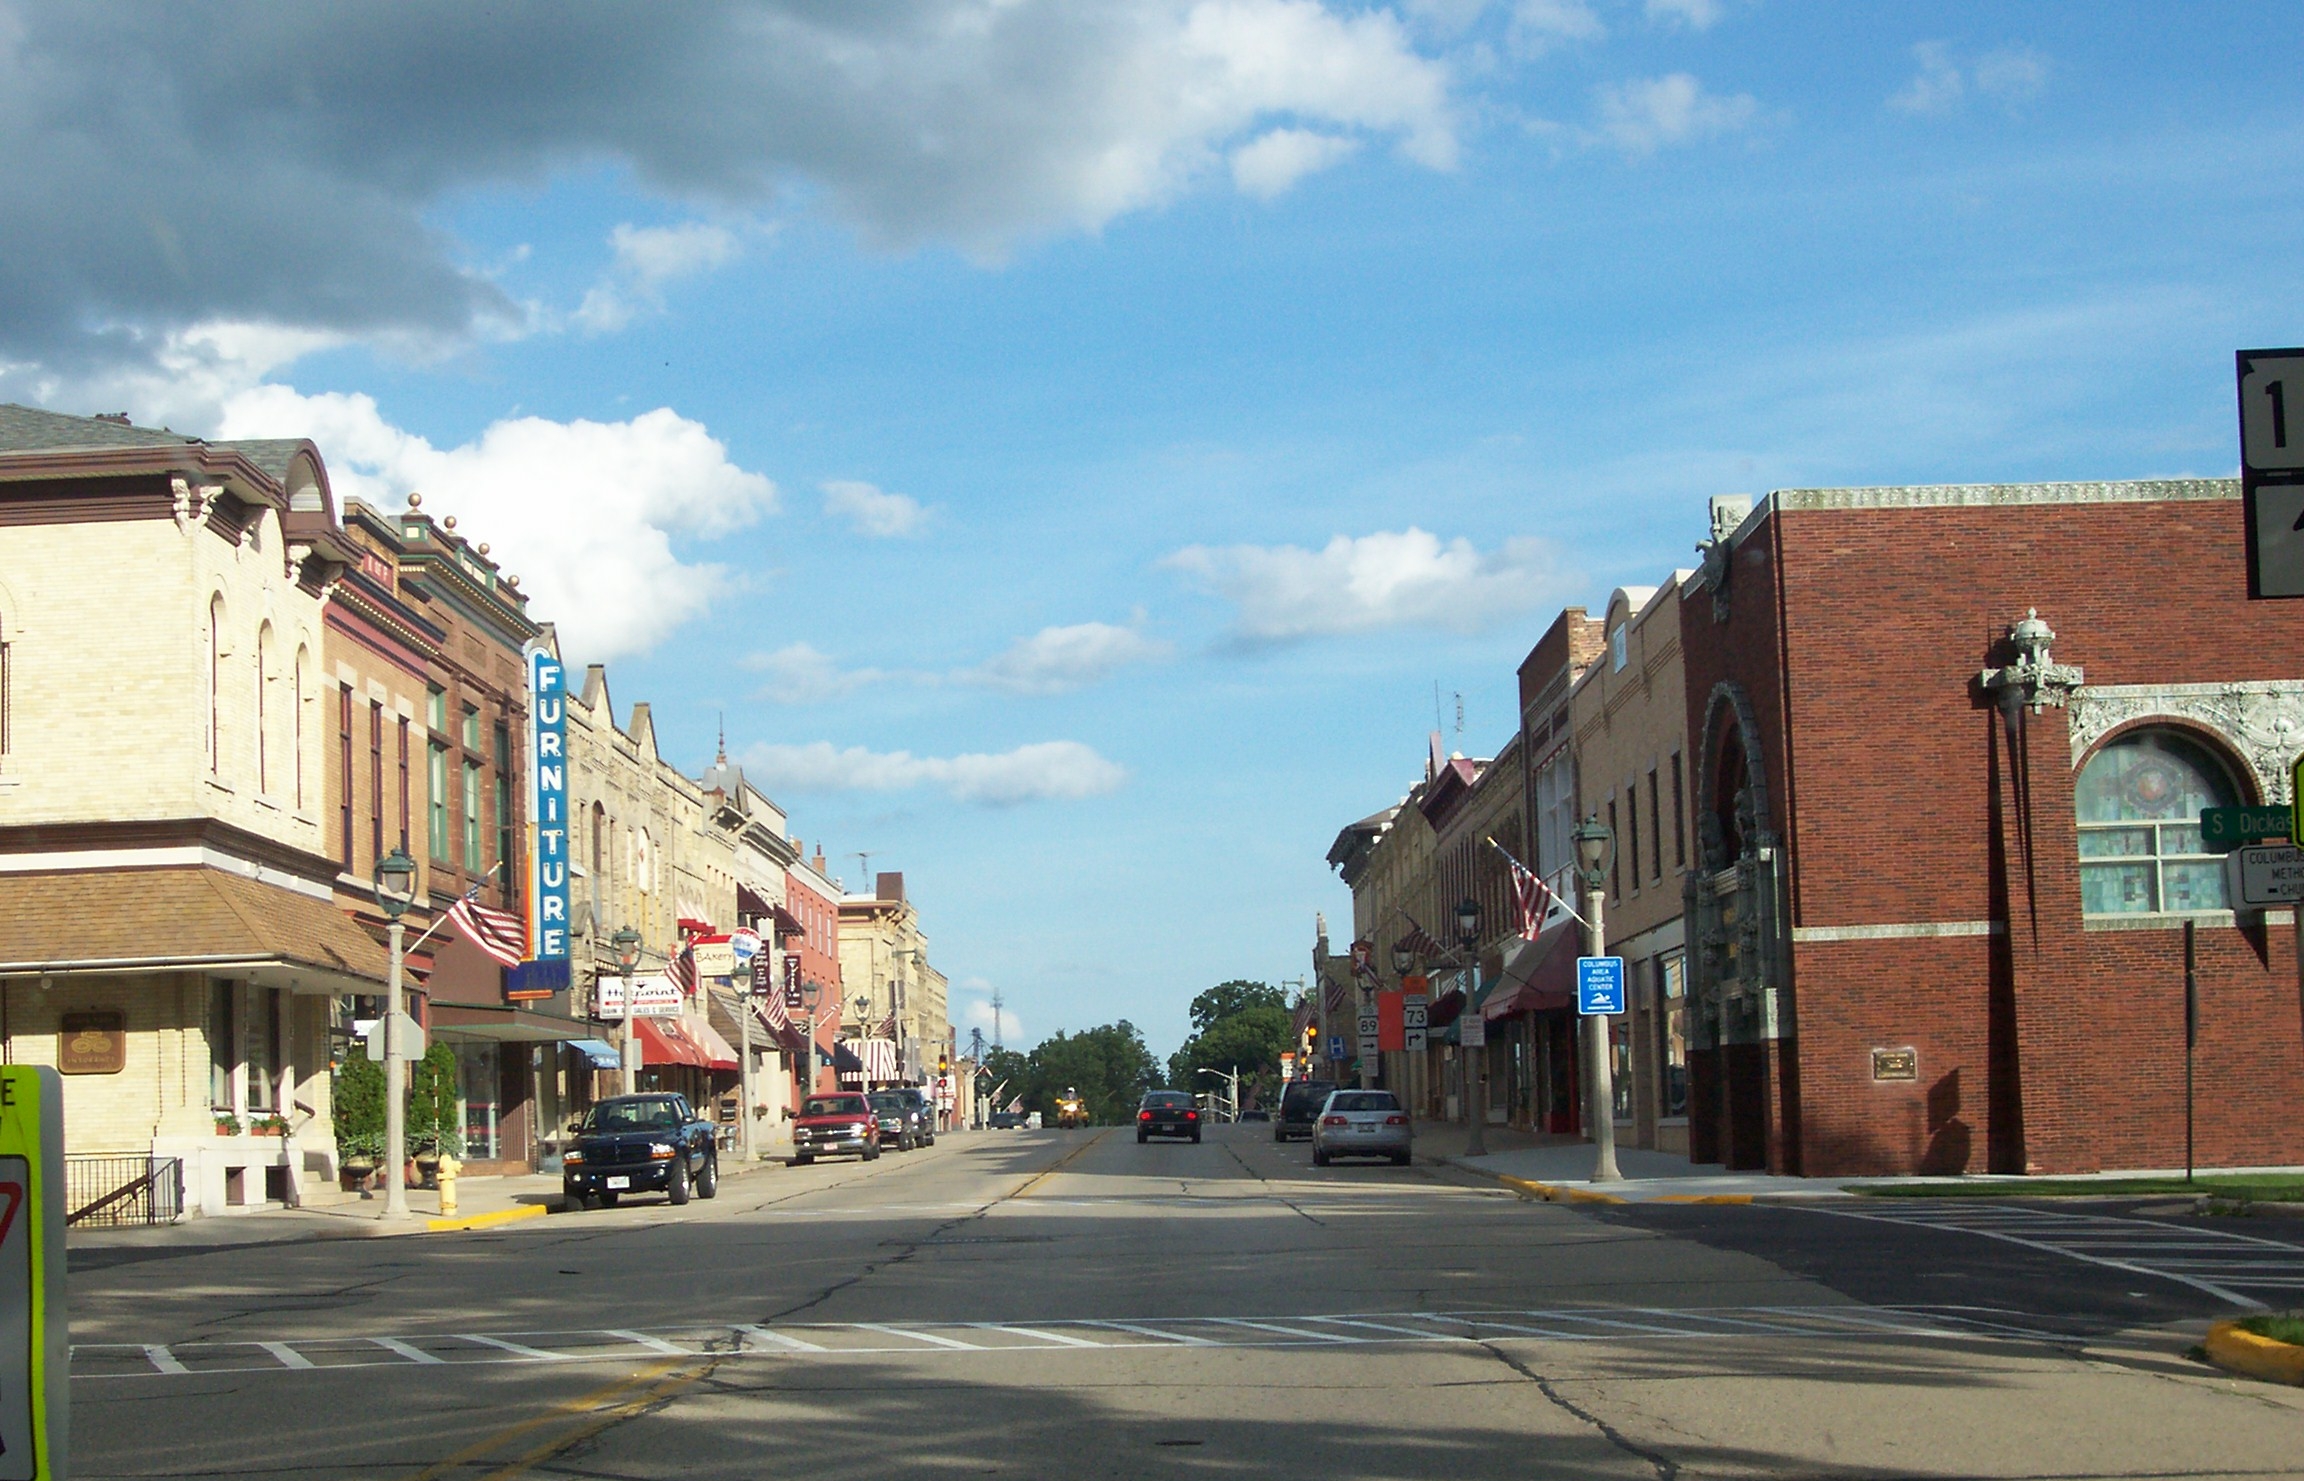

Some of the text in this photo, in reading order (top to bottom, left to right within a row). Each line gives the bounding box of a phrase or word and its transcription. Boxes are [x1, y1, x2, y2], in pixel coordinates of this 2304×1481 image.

[539, 666, 565, 955] FURNITURE
[2211, 813, 2224, 835] S
[1582, 960, 1618, 968] COLUMBUS
[1589, 983, 1613, 991] CENTER
[605, 988, 678, 999] Hopoint
[1407, 1010, 1425, 1023] 73
[1361, 1020, 1377, 1032] 89
[1330, 1037, 1344, 1054] H
